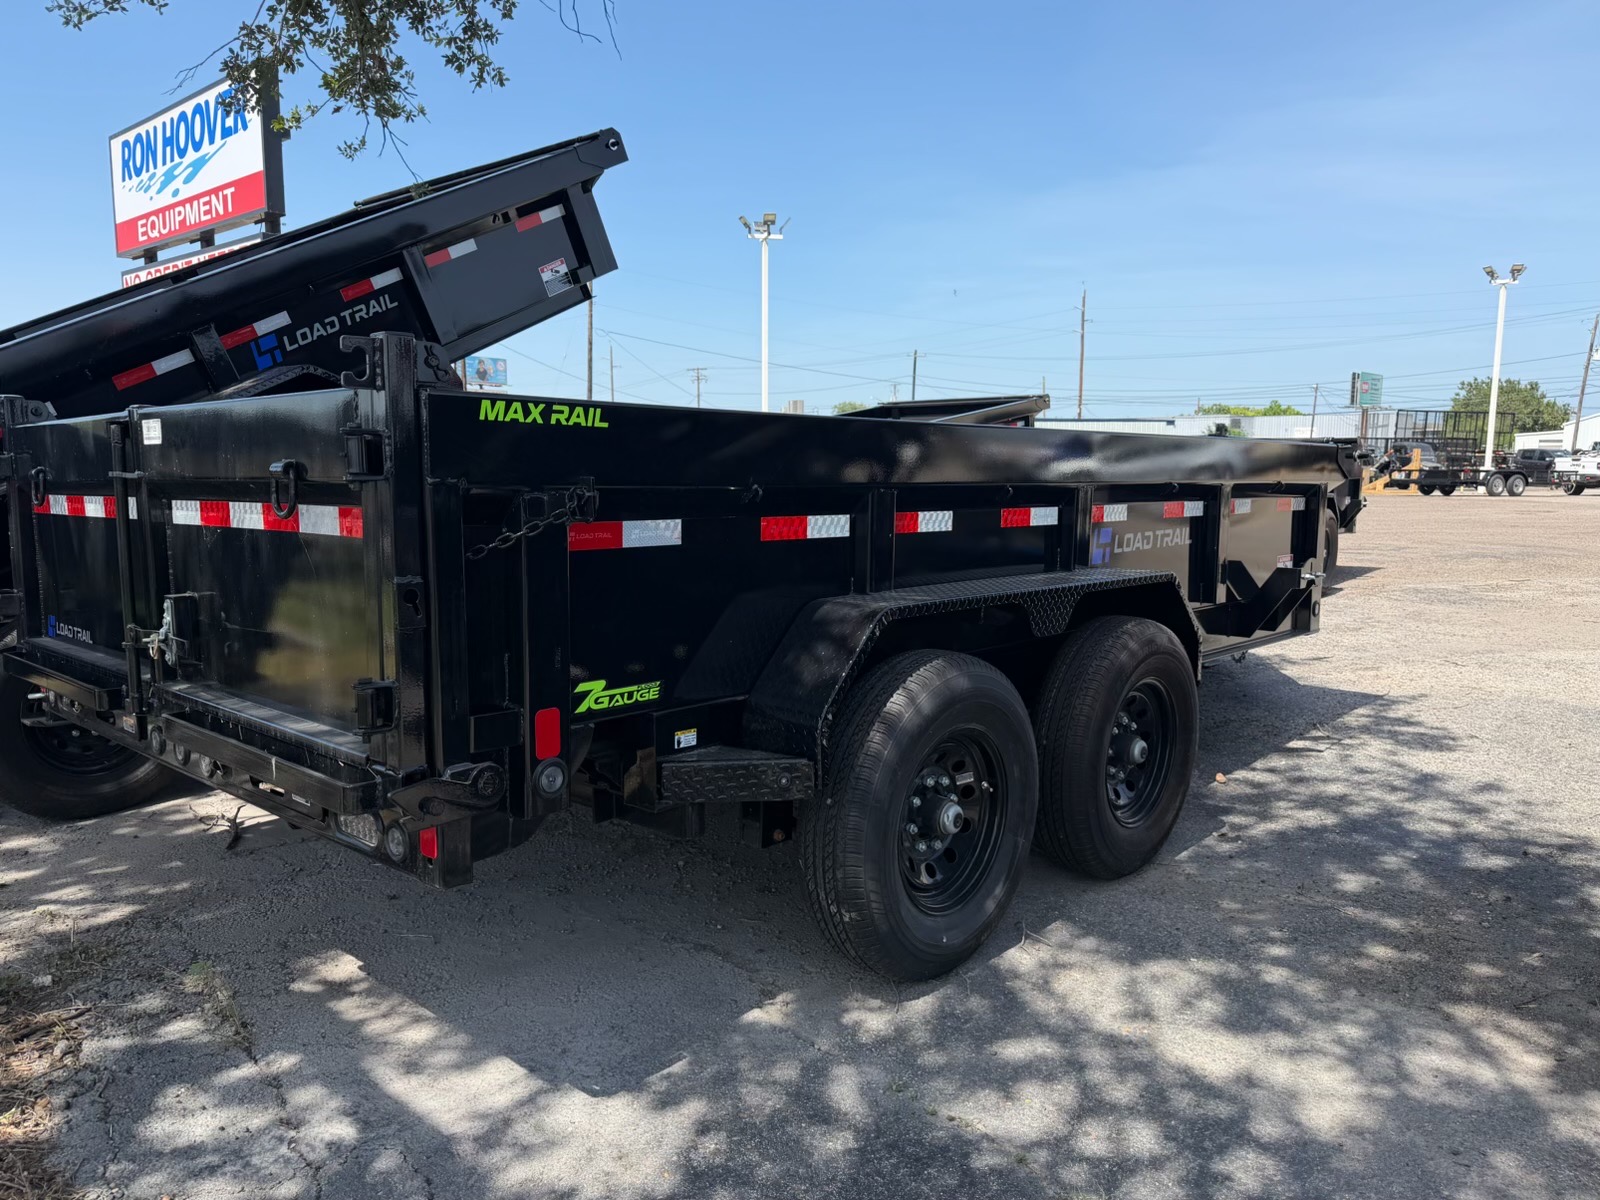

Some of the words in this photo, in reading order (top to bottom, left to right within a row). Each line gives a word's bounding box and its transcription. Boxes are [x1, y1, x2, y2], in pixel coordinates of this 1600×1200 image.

[121, 125, 157, 182] RON
[137, 187, 235, 241] EQUIPMENT
[283, 315, 340, 351] LOAD
[340, 294, 398, 326] TRAIL
[479, 399, 545, 424] MAX
[550, 405, 609, 427] RAIL
[1114, 531, 1153, 554] LOAD
[1155, 526, 1192, 548] TRAIL
[56, 621, 73, 638] LOAD
[73, 626, 93, 644] TRAIL
